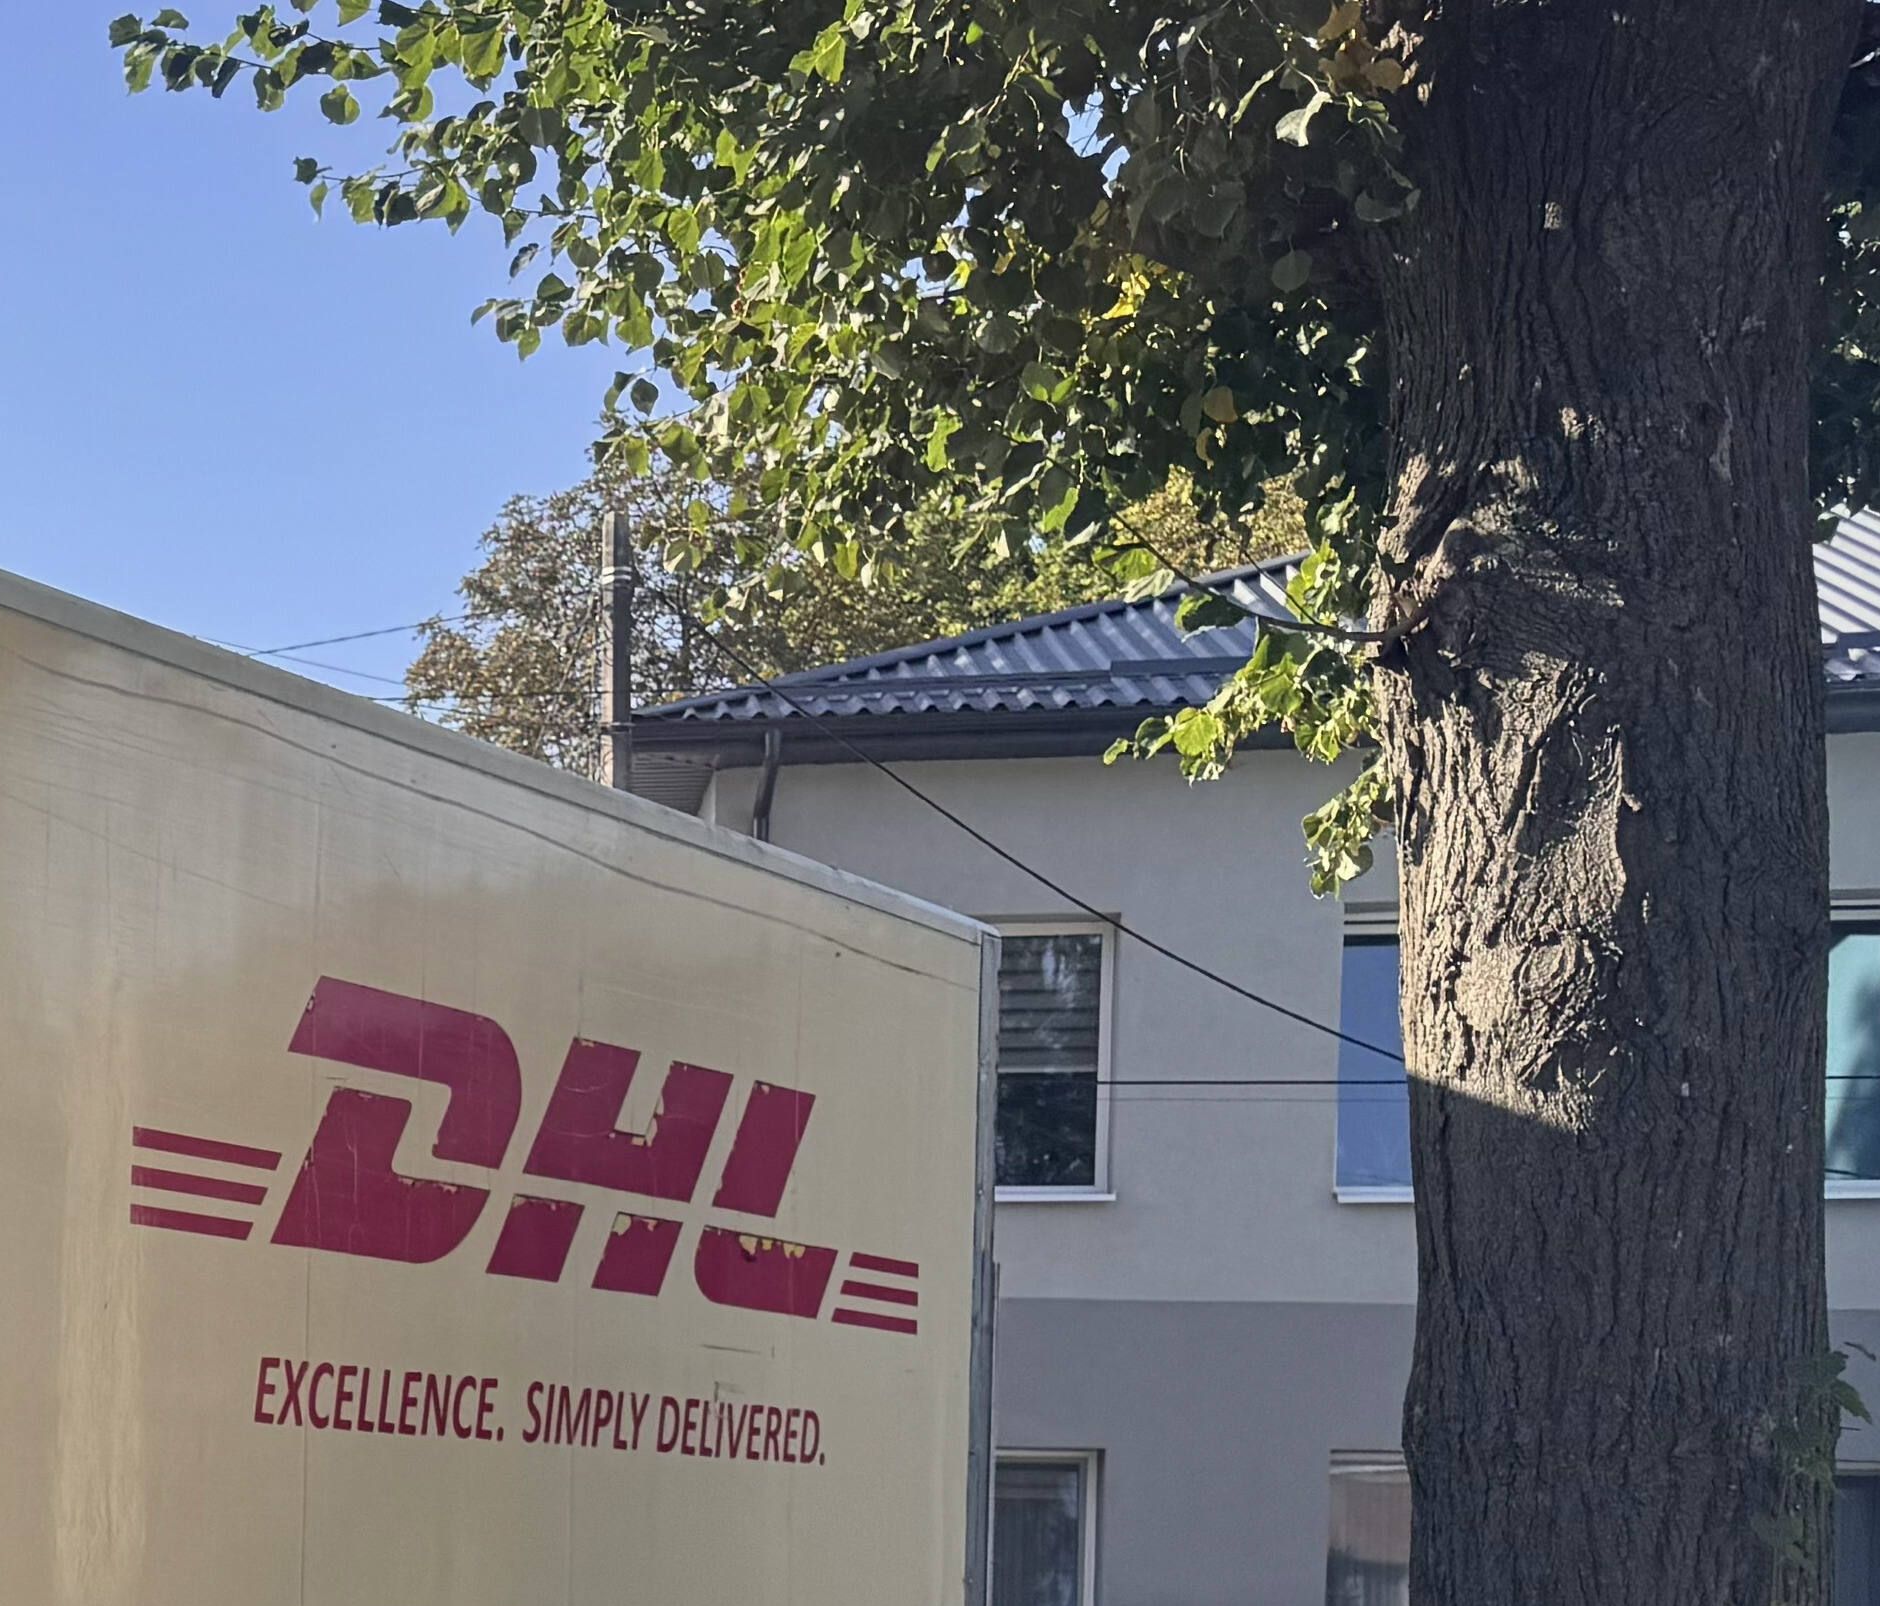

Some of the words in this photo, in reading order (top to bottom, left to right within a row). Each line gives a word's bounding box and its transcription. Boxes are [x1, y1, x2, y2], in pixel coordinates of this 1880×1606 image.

[270, 975, 838, 1319] DHL
[254, 1357, 504, 1441] EXCELLENCE.
[521, 1381, 649, 1452] SIMPLY
[657, 1397, 826, 1466] DELIVERED.
